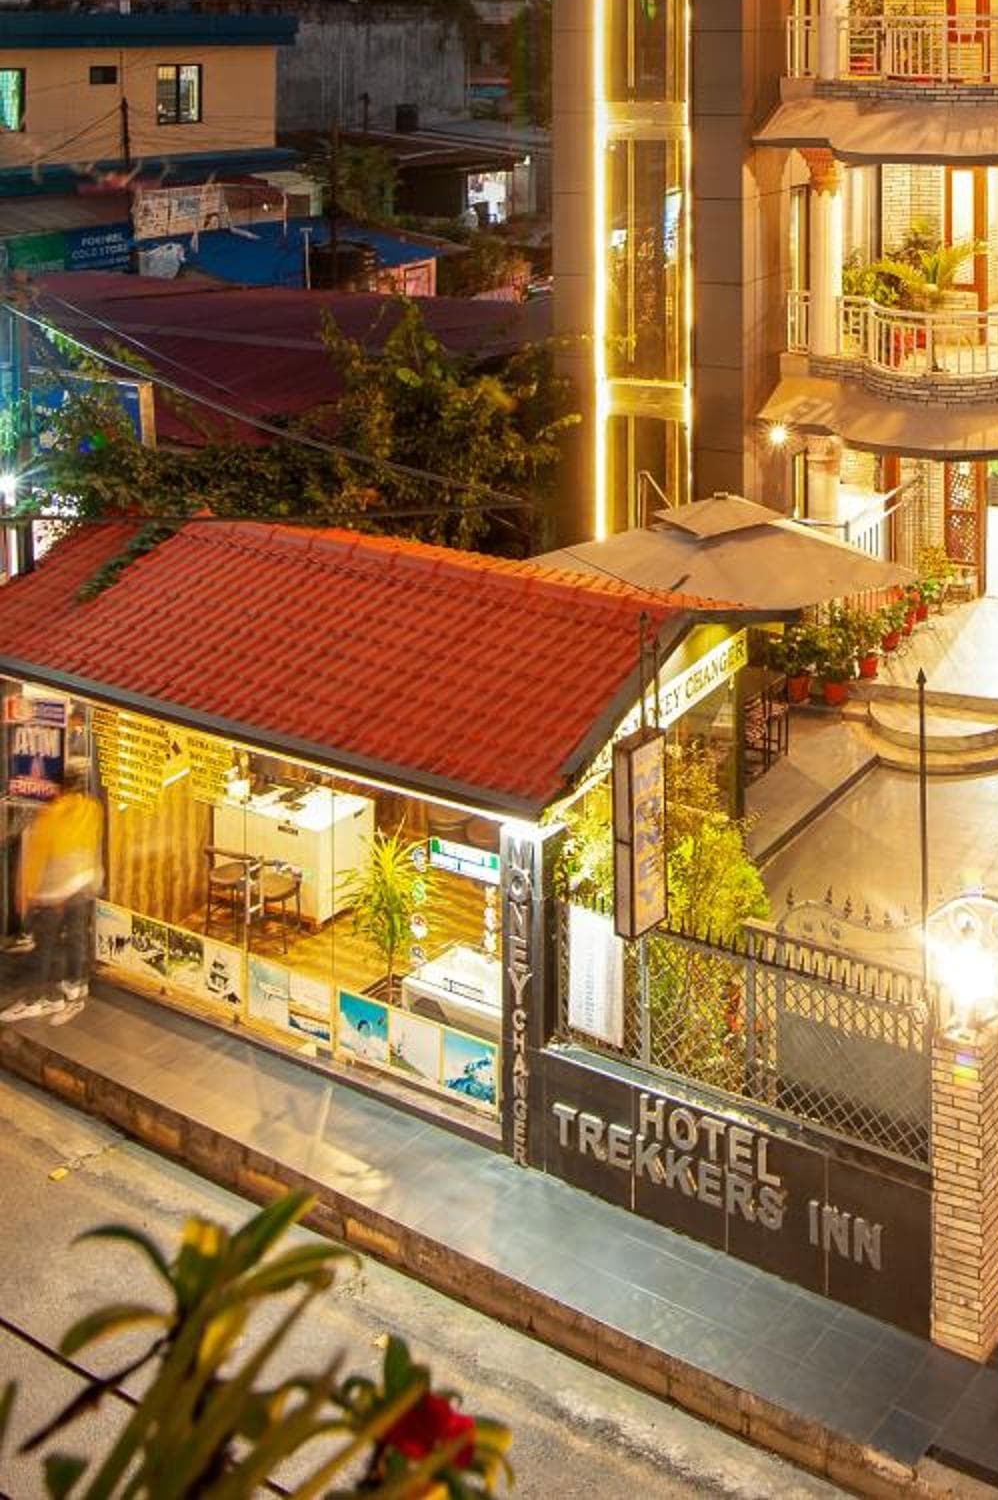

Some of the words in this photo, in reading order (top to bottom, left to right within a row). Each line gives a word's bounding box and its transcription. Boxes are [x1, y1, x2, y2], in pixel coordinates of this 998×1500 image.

[685, 638, 745, 700] CHANGER
[508, 832, 533, 1005] MONEY
[511, 1007, 530, 1169] CHANGER
[639, 1092, 782, 1188] HOTEL
[551, 1102, 789, 1232] TREKKERS
[808, 1199, 884, 1272] INN
